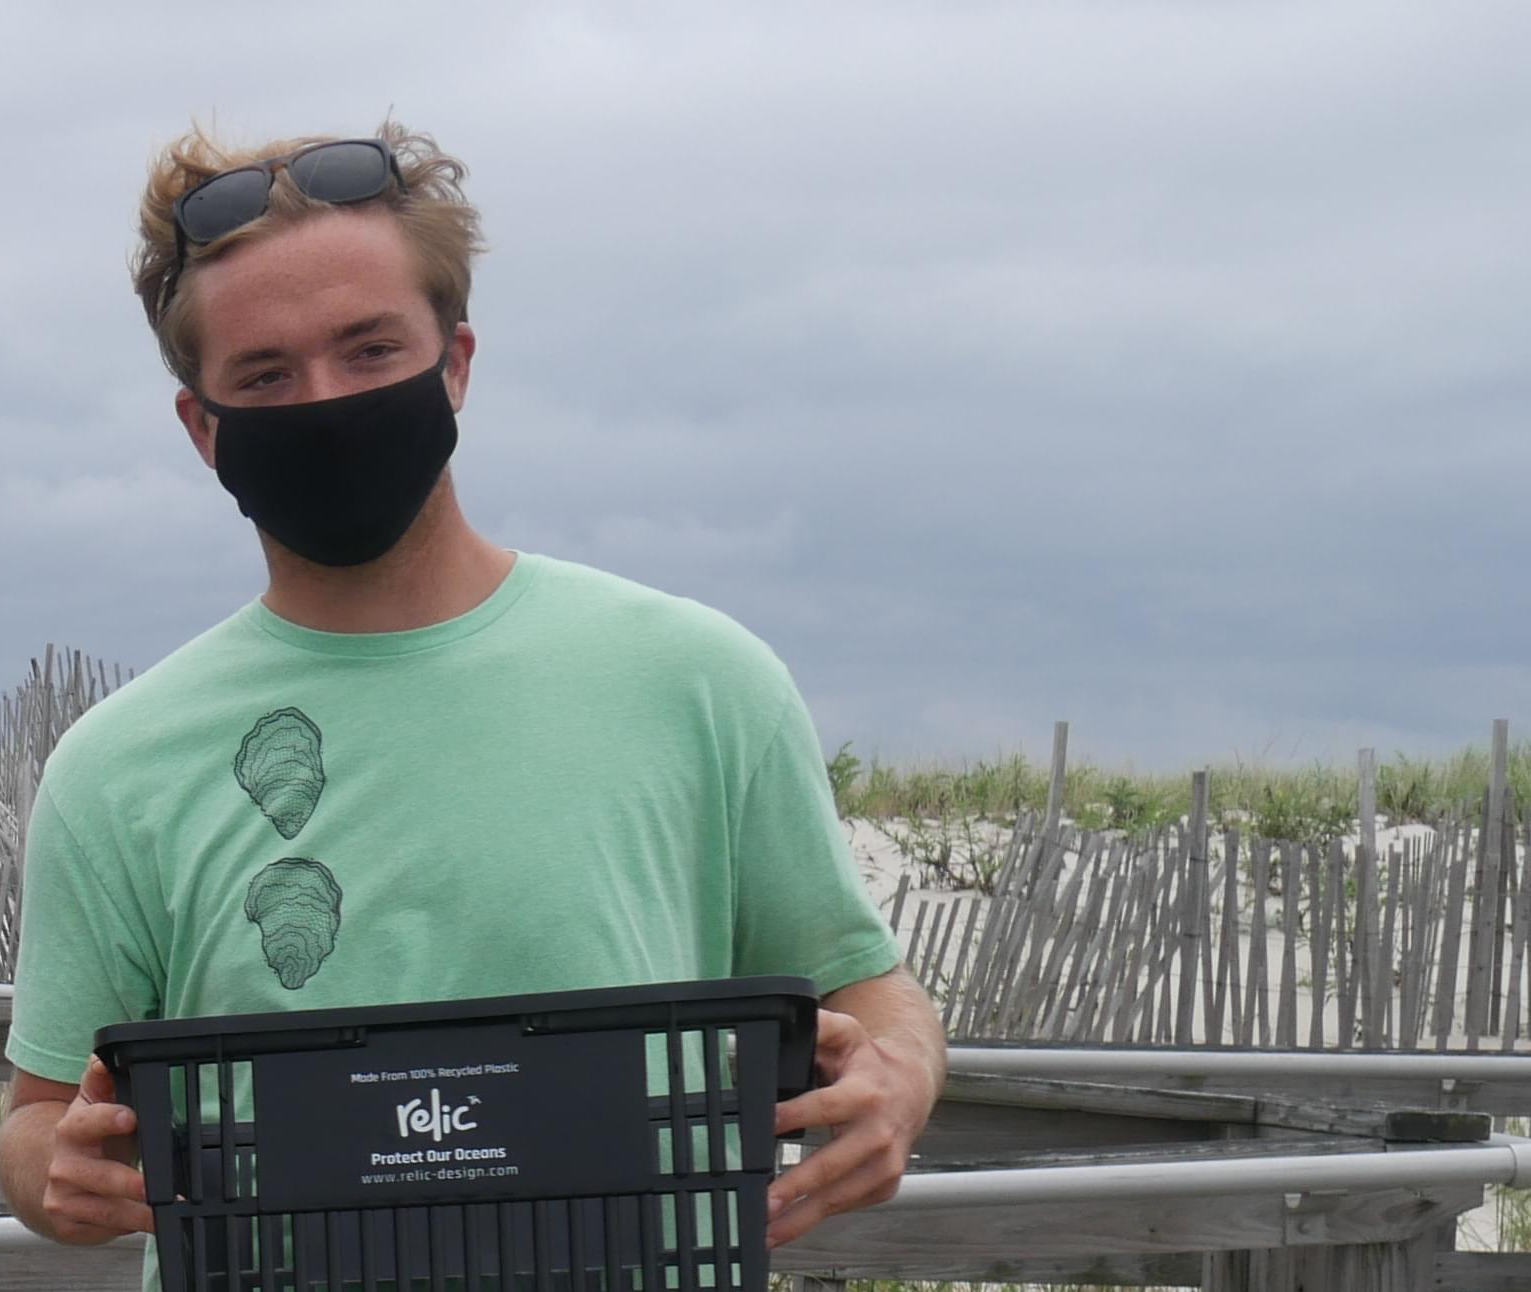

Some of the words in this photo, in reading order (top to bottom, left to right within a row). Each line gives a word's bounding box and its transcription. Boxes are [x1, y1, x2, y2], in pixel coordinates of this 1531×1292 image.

[397, 1088, 477, 1141] relic
[371, 1152, 423, 1165] Protect
[427, 1150, 452, 1162] Our
[455, 1147, 507, 1160] Oceans
[361, 1165, 518, 1184] www.relic-design.com
